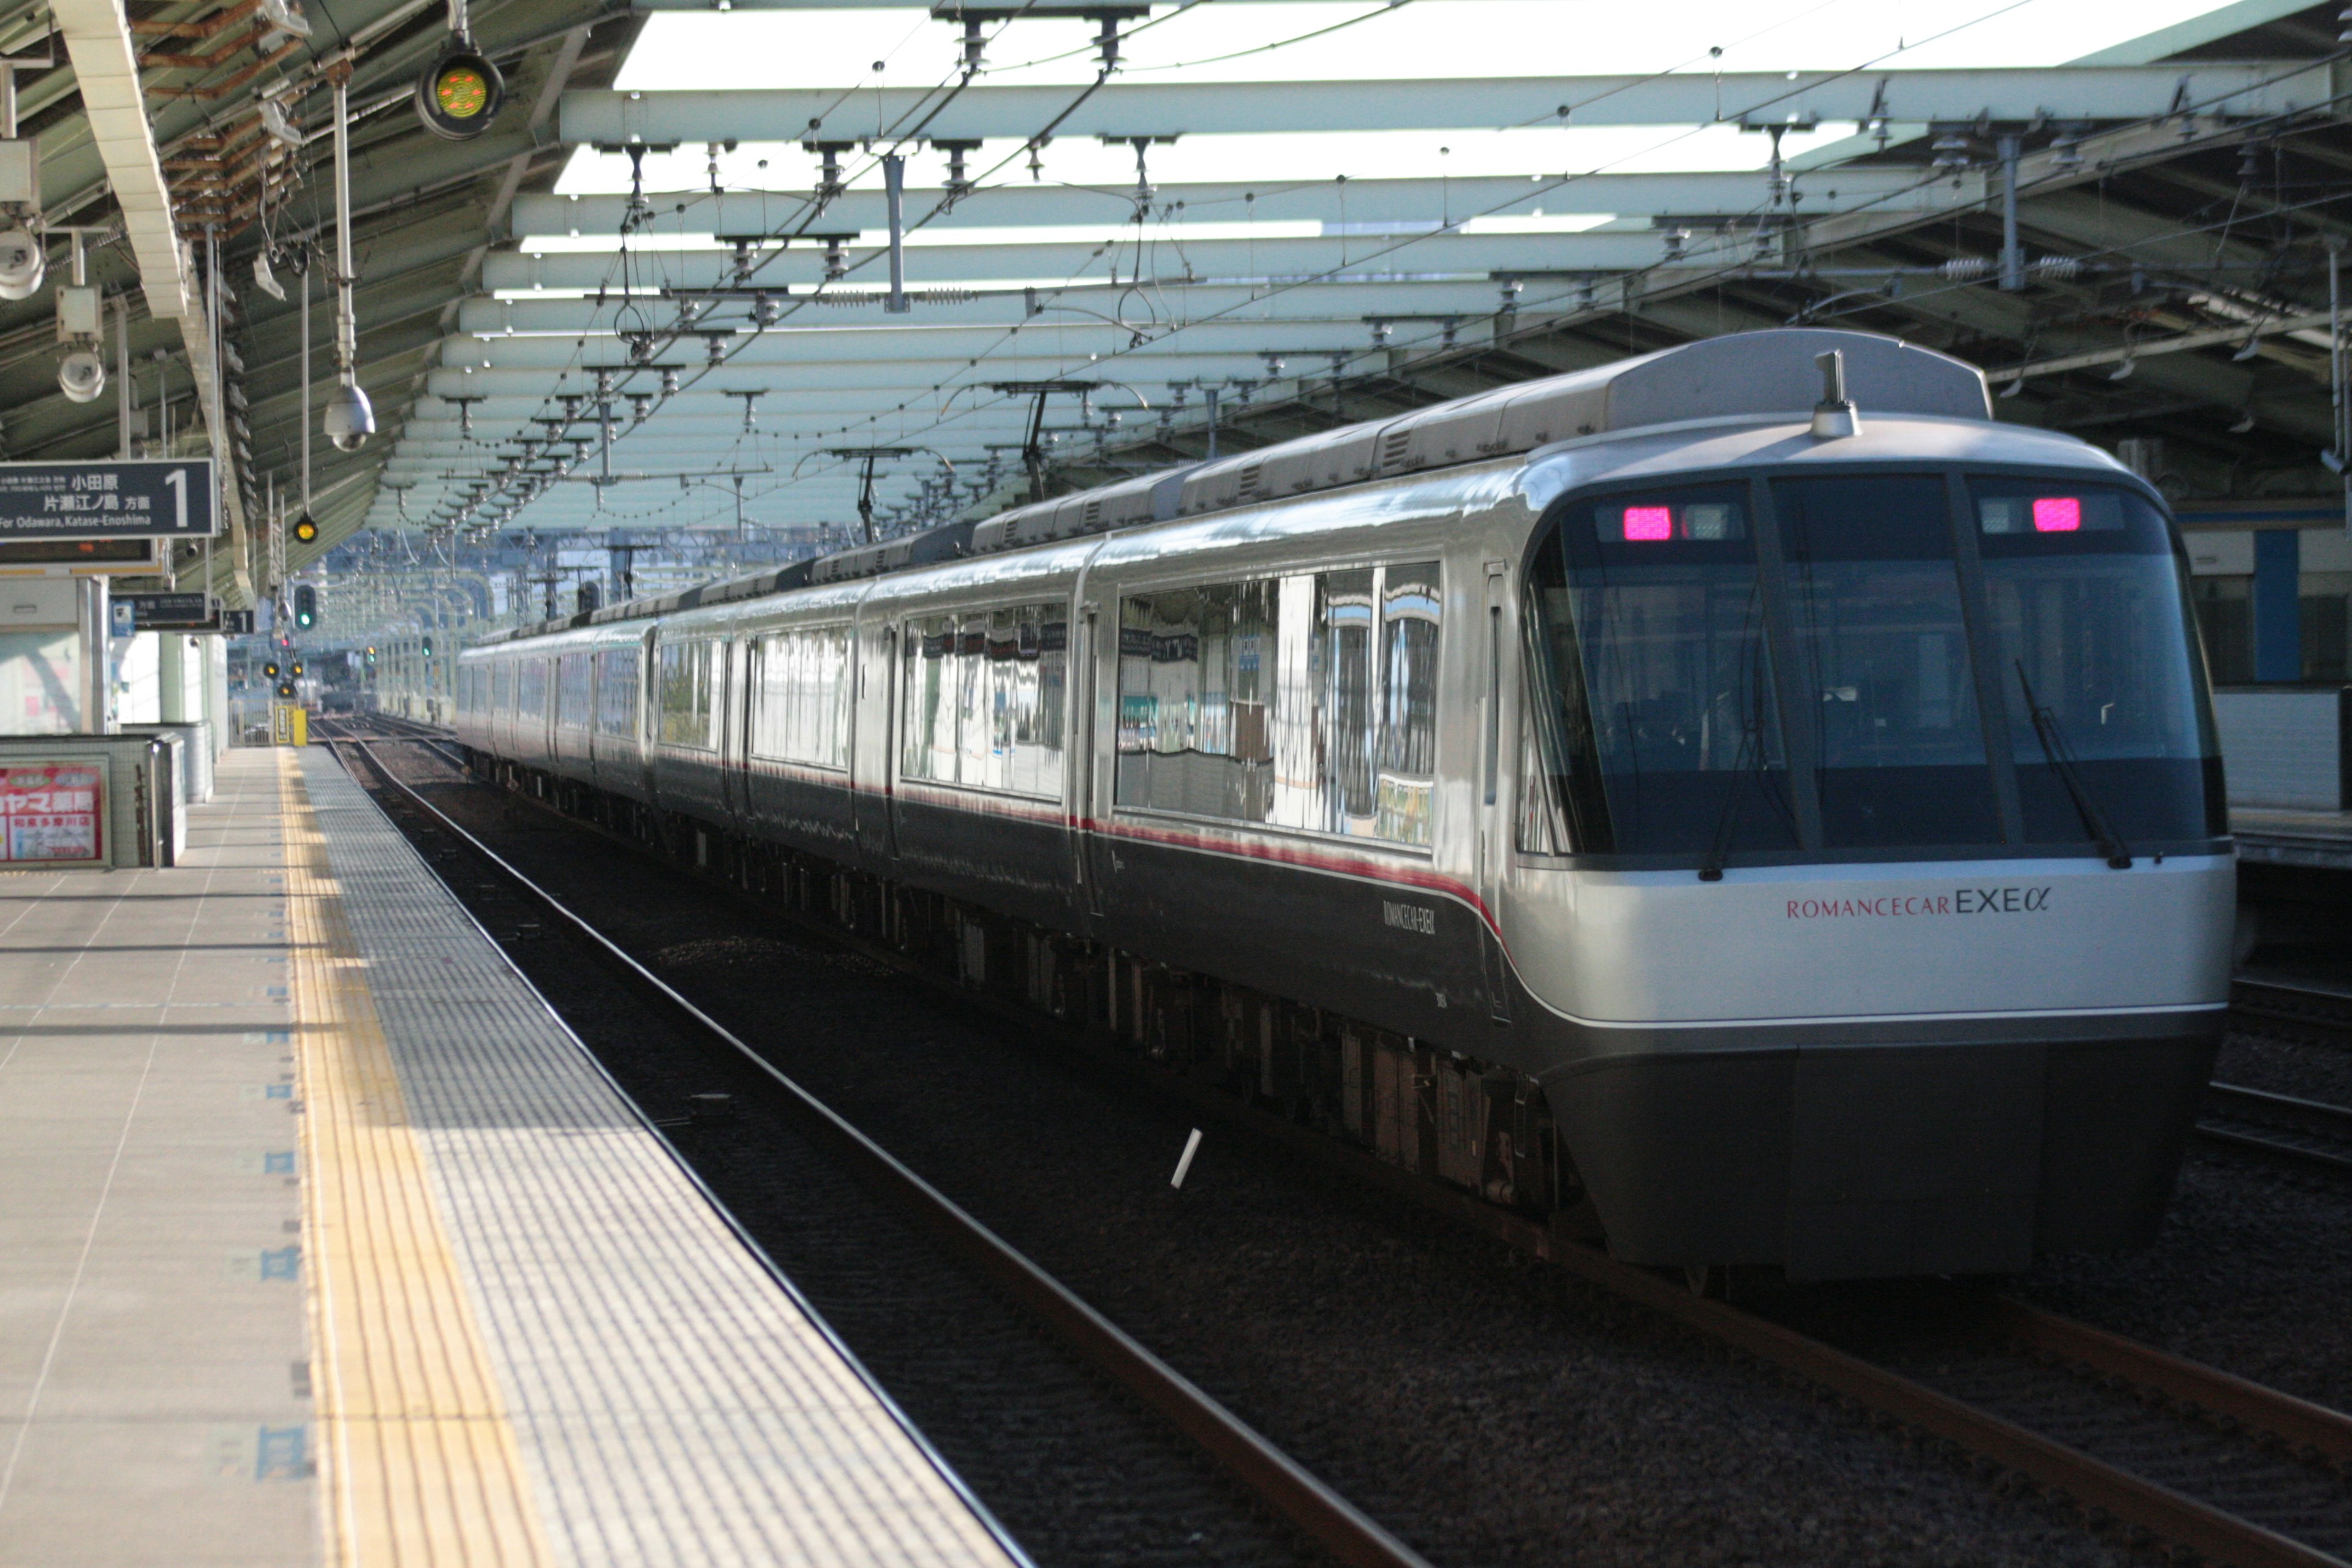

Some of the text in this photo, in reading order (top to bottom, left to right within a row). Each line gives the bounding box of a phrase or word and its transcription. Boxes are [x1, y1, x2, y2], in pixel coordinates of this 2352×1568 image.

[71, 473, 119, 491] 小田原
[43, 494, 151, 512] 片瀬江ノ島 方面
[165, 469, 188, 528] 1
[17, 515, 64, 529] Odawara,
[65, 514, 151, 527] Katase-Enoshima
[0, 791, 94, 813] ヤマ薬局
[1787, 896, 1950, 919] ROMANCECAR
